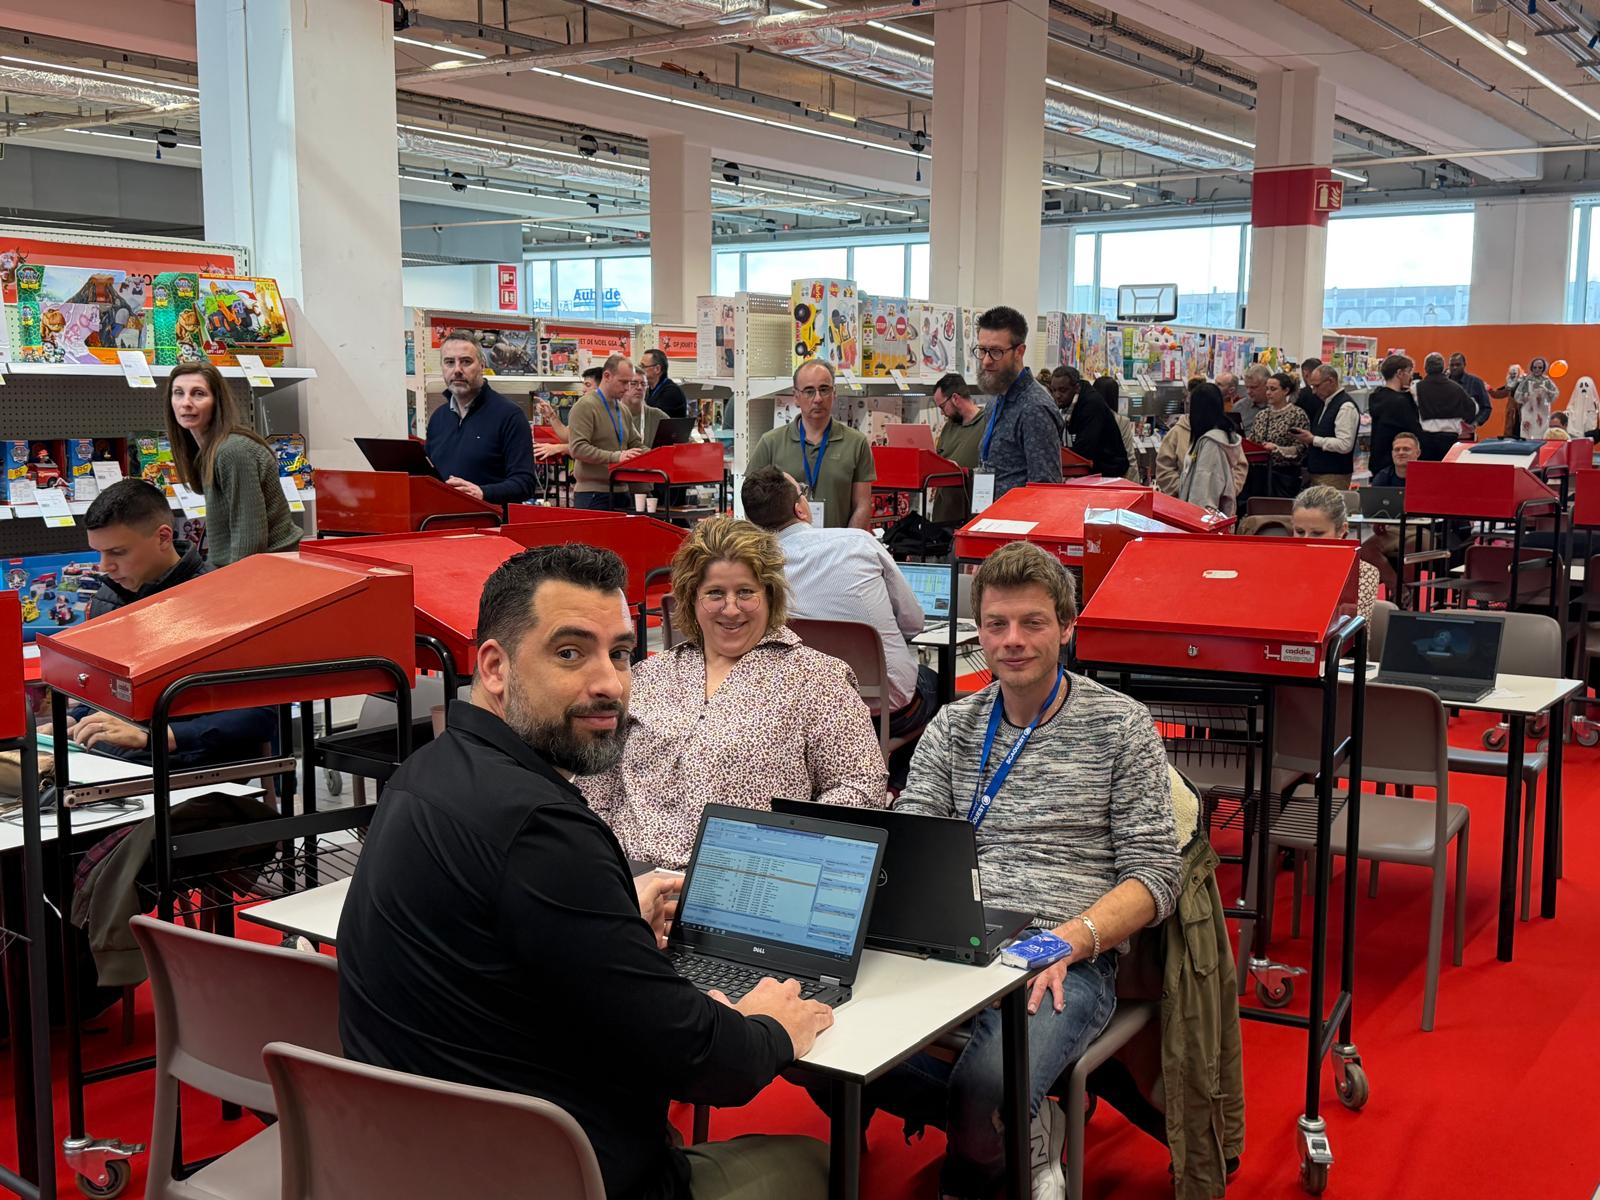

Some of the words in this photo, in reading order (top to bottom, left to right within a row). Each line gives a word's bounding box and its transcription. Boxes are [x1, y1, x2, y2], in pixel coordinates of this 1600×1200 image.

[574, 288, 620, 301] Aubde
[972, 805, 985, 824] QUEST
[752, 946, 765, 954] DELL
